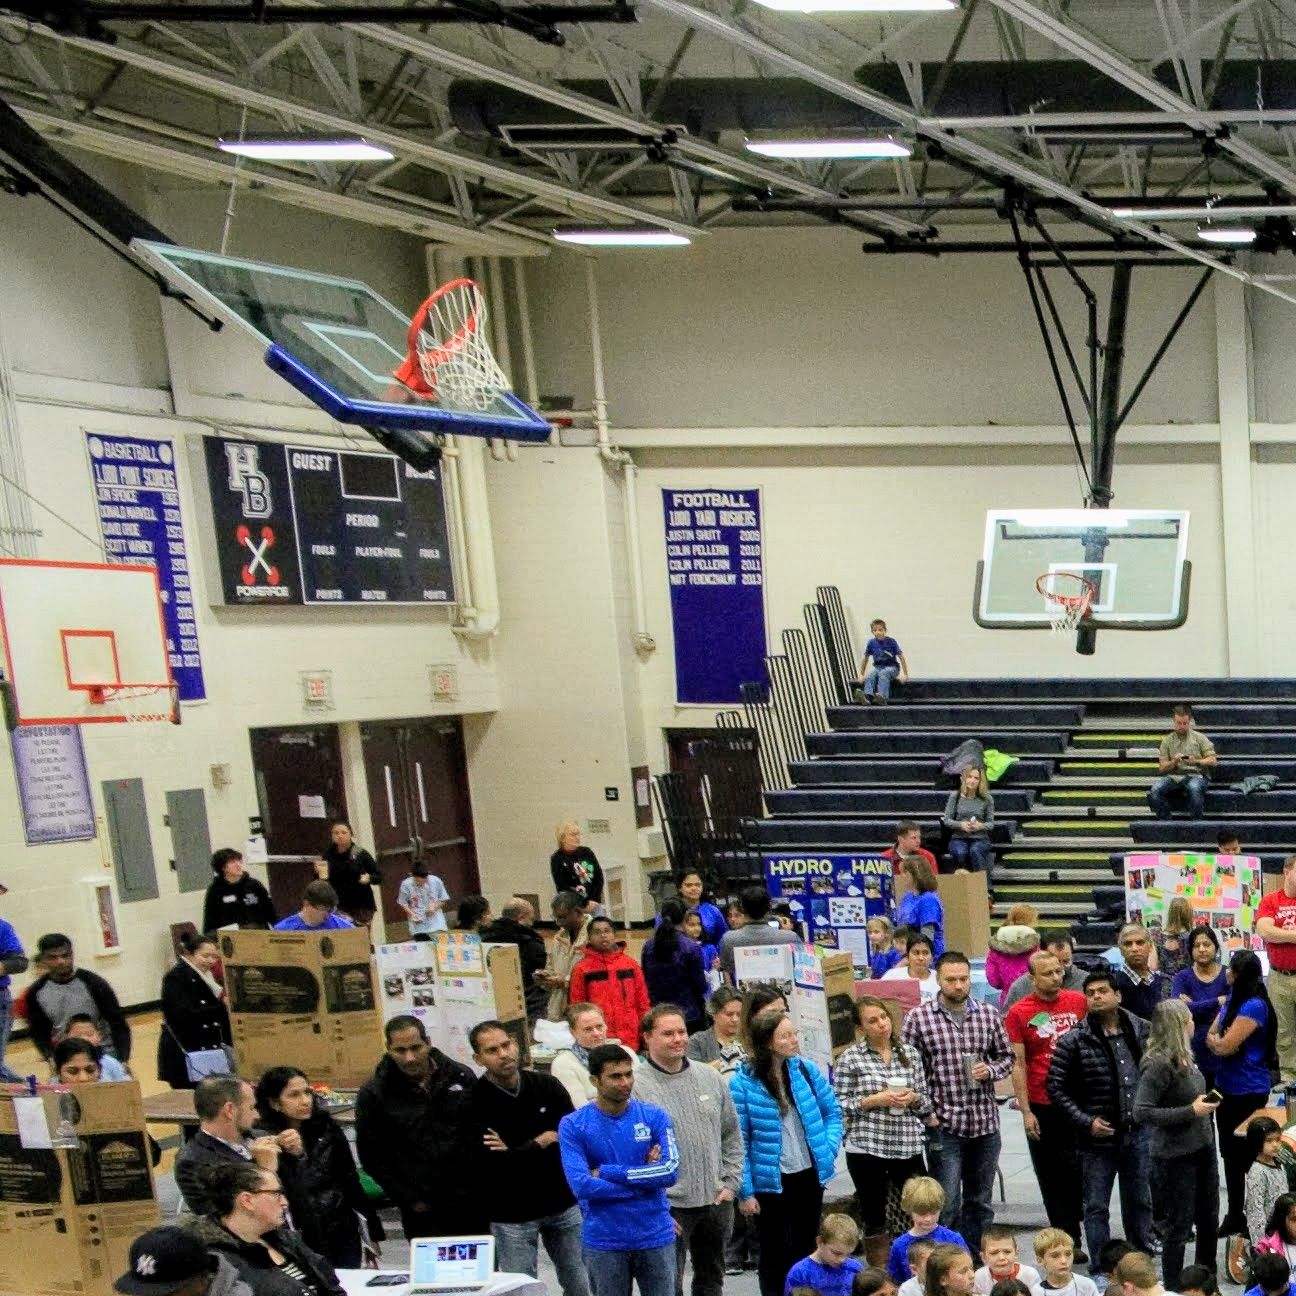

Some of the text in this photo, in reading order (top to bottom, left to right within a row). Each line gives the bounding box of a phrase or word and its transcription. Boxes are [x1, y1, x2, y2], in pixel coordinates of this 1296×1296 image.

[104, 442, 157, 462] BASKETBALL
[292, 453, 333, 472] GUEST
[673, 493, 750, 507] FOOTBALL
[346, 514, 380, 528] PERIOD
[770, 859, 833, 876] HYDRO
